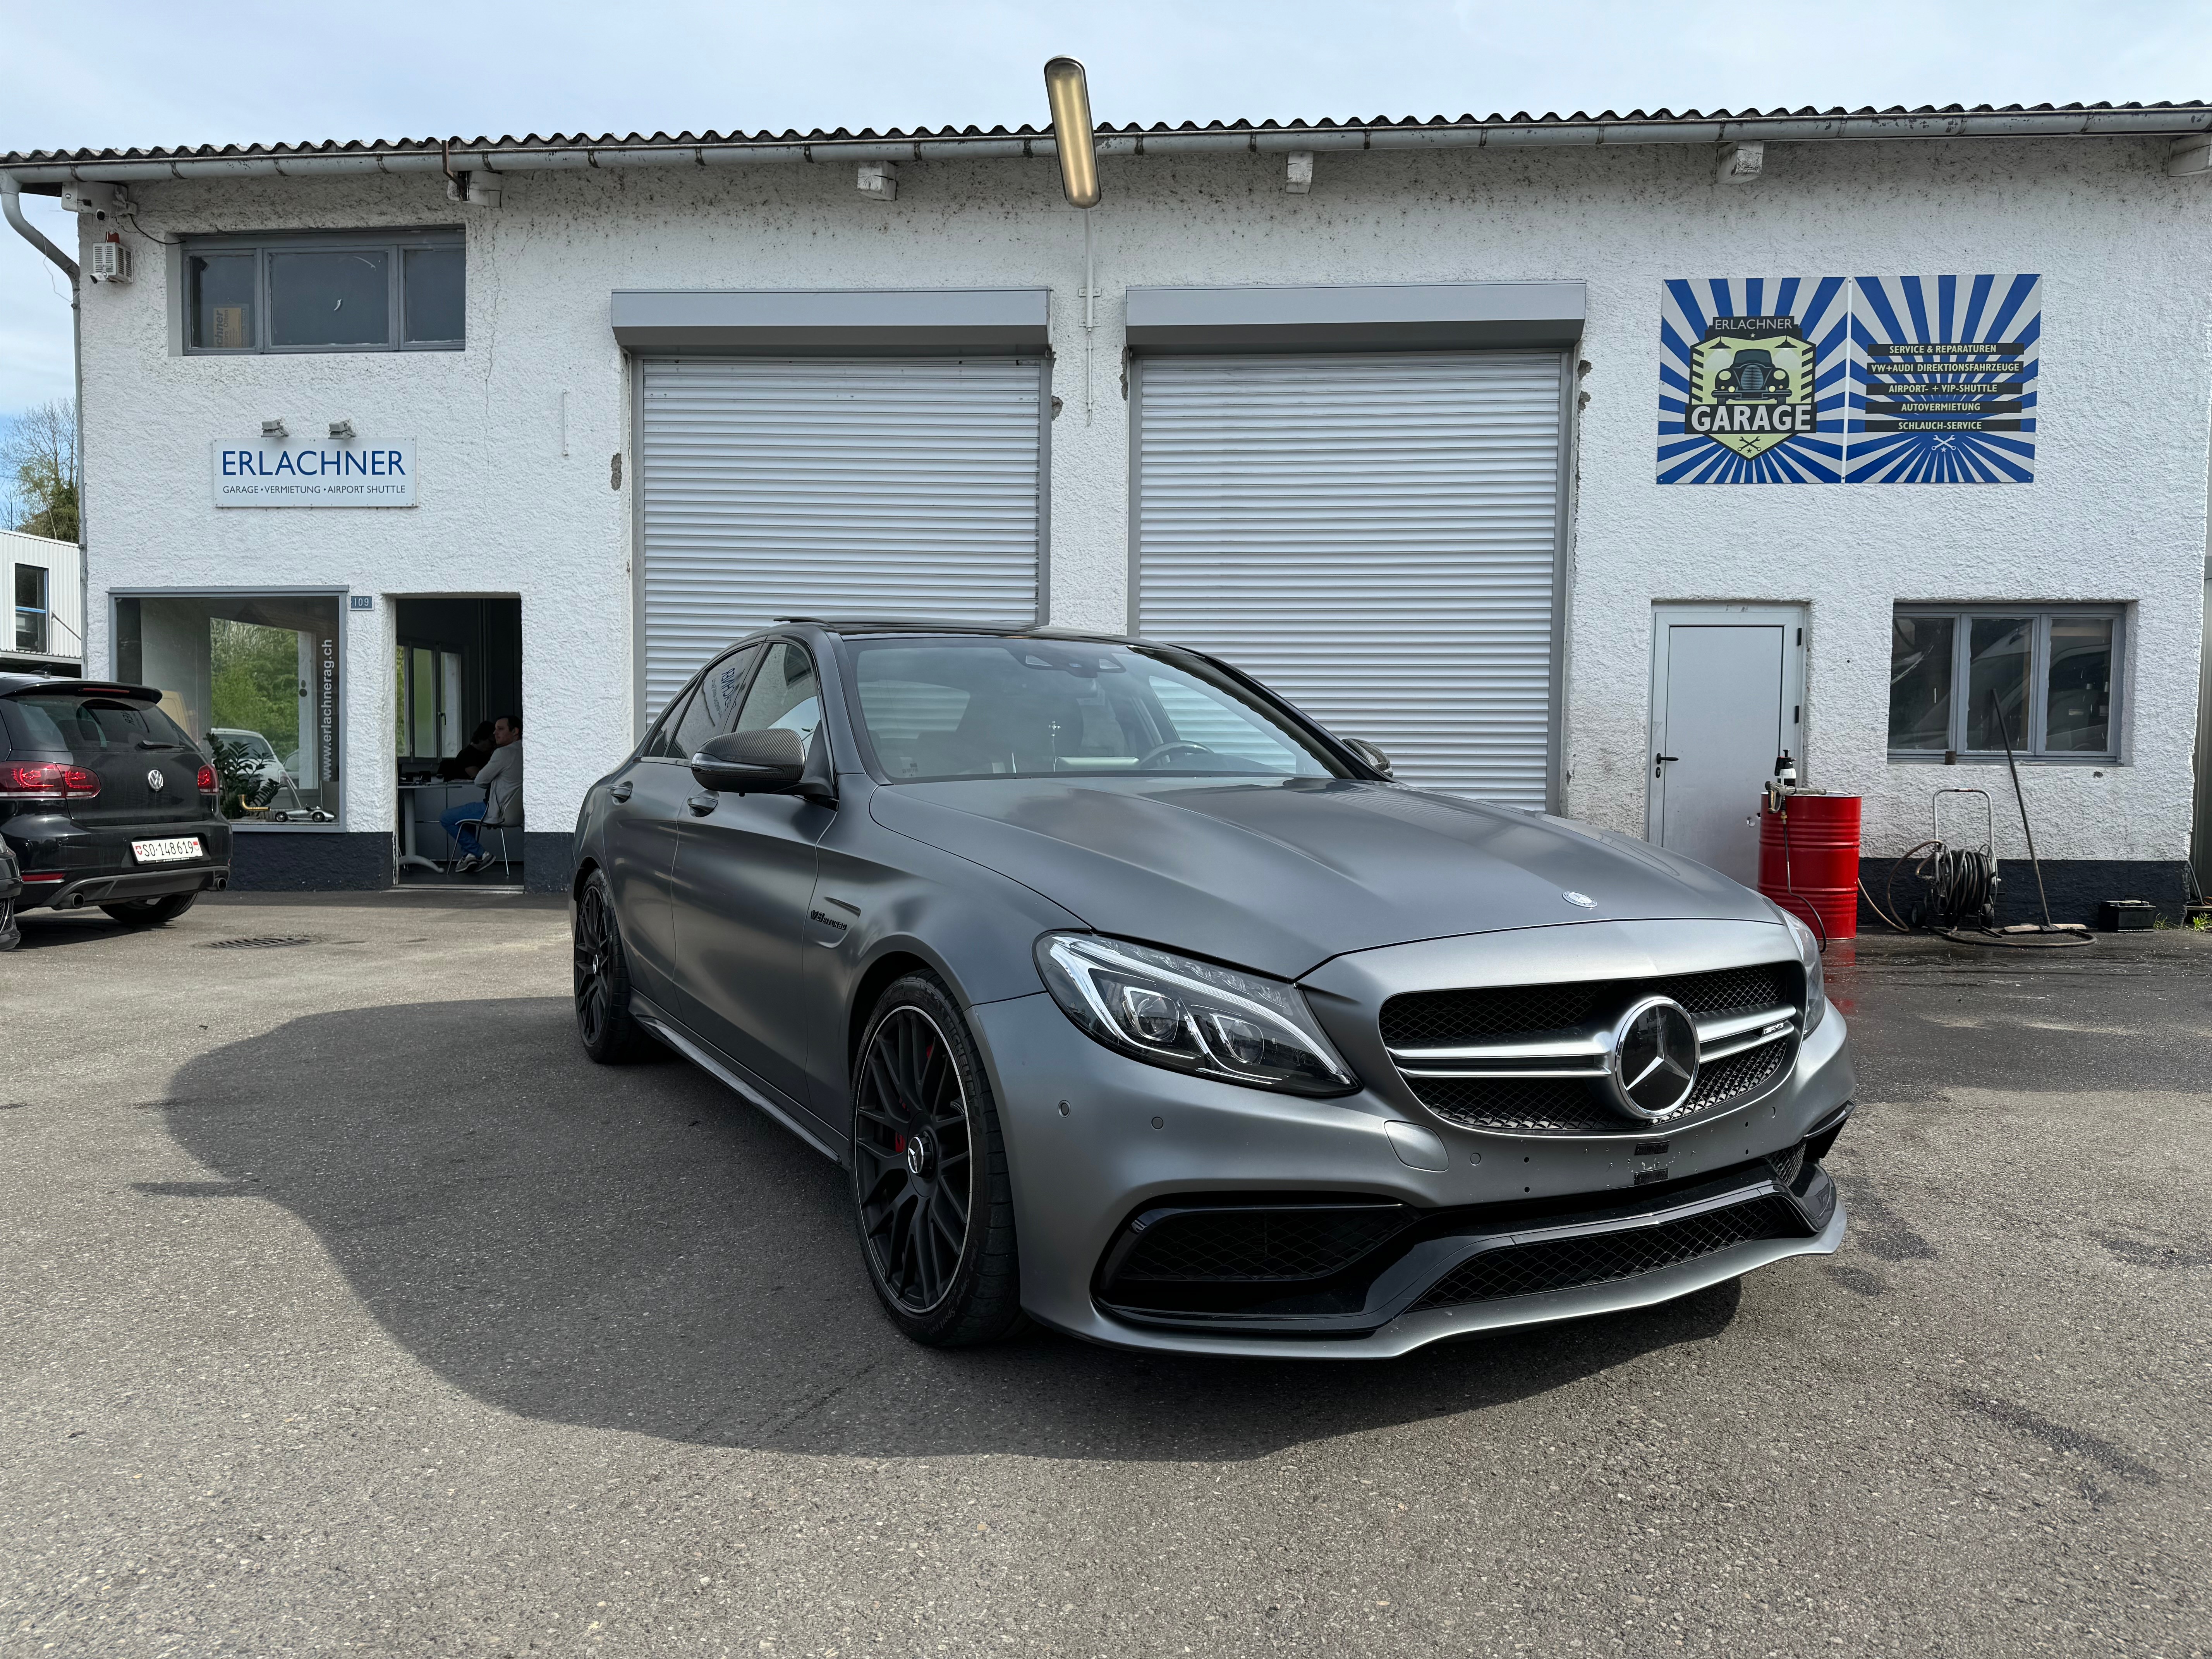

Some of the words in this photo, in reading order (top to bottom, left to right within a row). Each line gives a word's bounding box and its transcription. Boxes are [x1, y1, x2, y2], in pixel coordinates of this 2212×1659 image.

[1715, 319, 1792, 330] ERLACHNER
[1889, 345, 1924, 354] SERVICE
[1936, 345, 1996, 353] REPARATUREN
[1871, 364, 1913, 372] VW+AUDI
[1917, 363, 2019, 372] DIREKTIONSFAHRZEUGE
[1889, 385, 1929, 393] AIRPORT-
[1941, 384, 1997, 392] VIP-SHUTTLE
[1901, 403, 1980, 411] AUTOVERMIETUNG
[1691, 405, 1811, 431] GARAGE
[1898, 421, 1982, 430] SCHLAUCH-SERVICE
[222, 450, 406, 476] ERLACHNER
[223, 486, 259, 494] GARAGE
[264, 485, 321, 494] VERMIETUNG
[327, 485, 364, 494] AIRPORT
[367, 485, 405, 494] SHUTTLE
[354, 598, 369, 606] 109
[321, 639, 335, 781] www.erlachnerag.ch
[822, 917, 847, 931] BITURBO
[943, 1016, 976, 1096] MICHELIN
